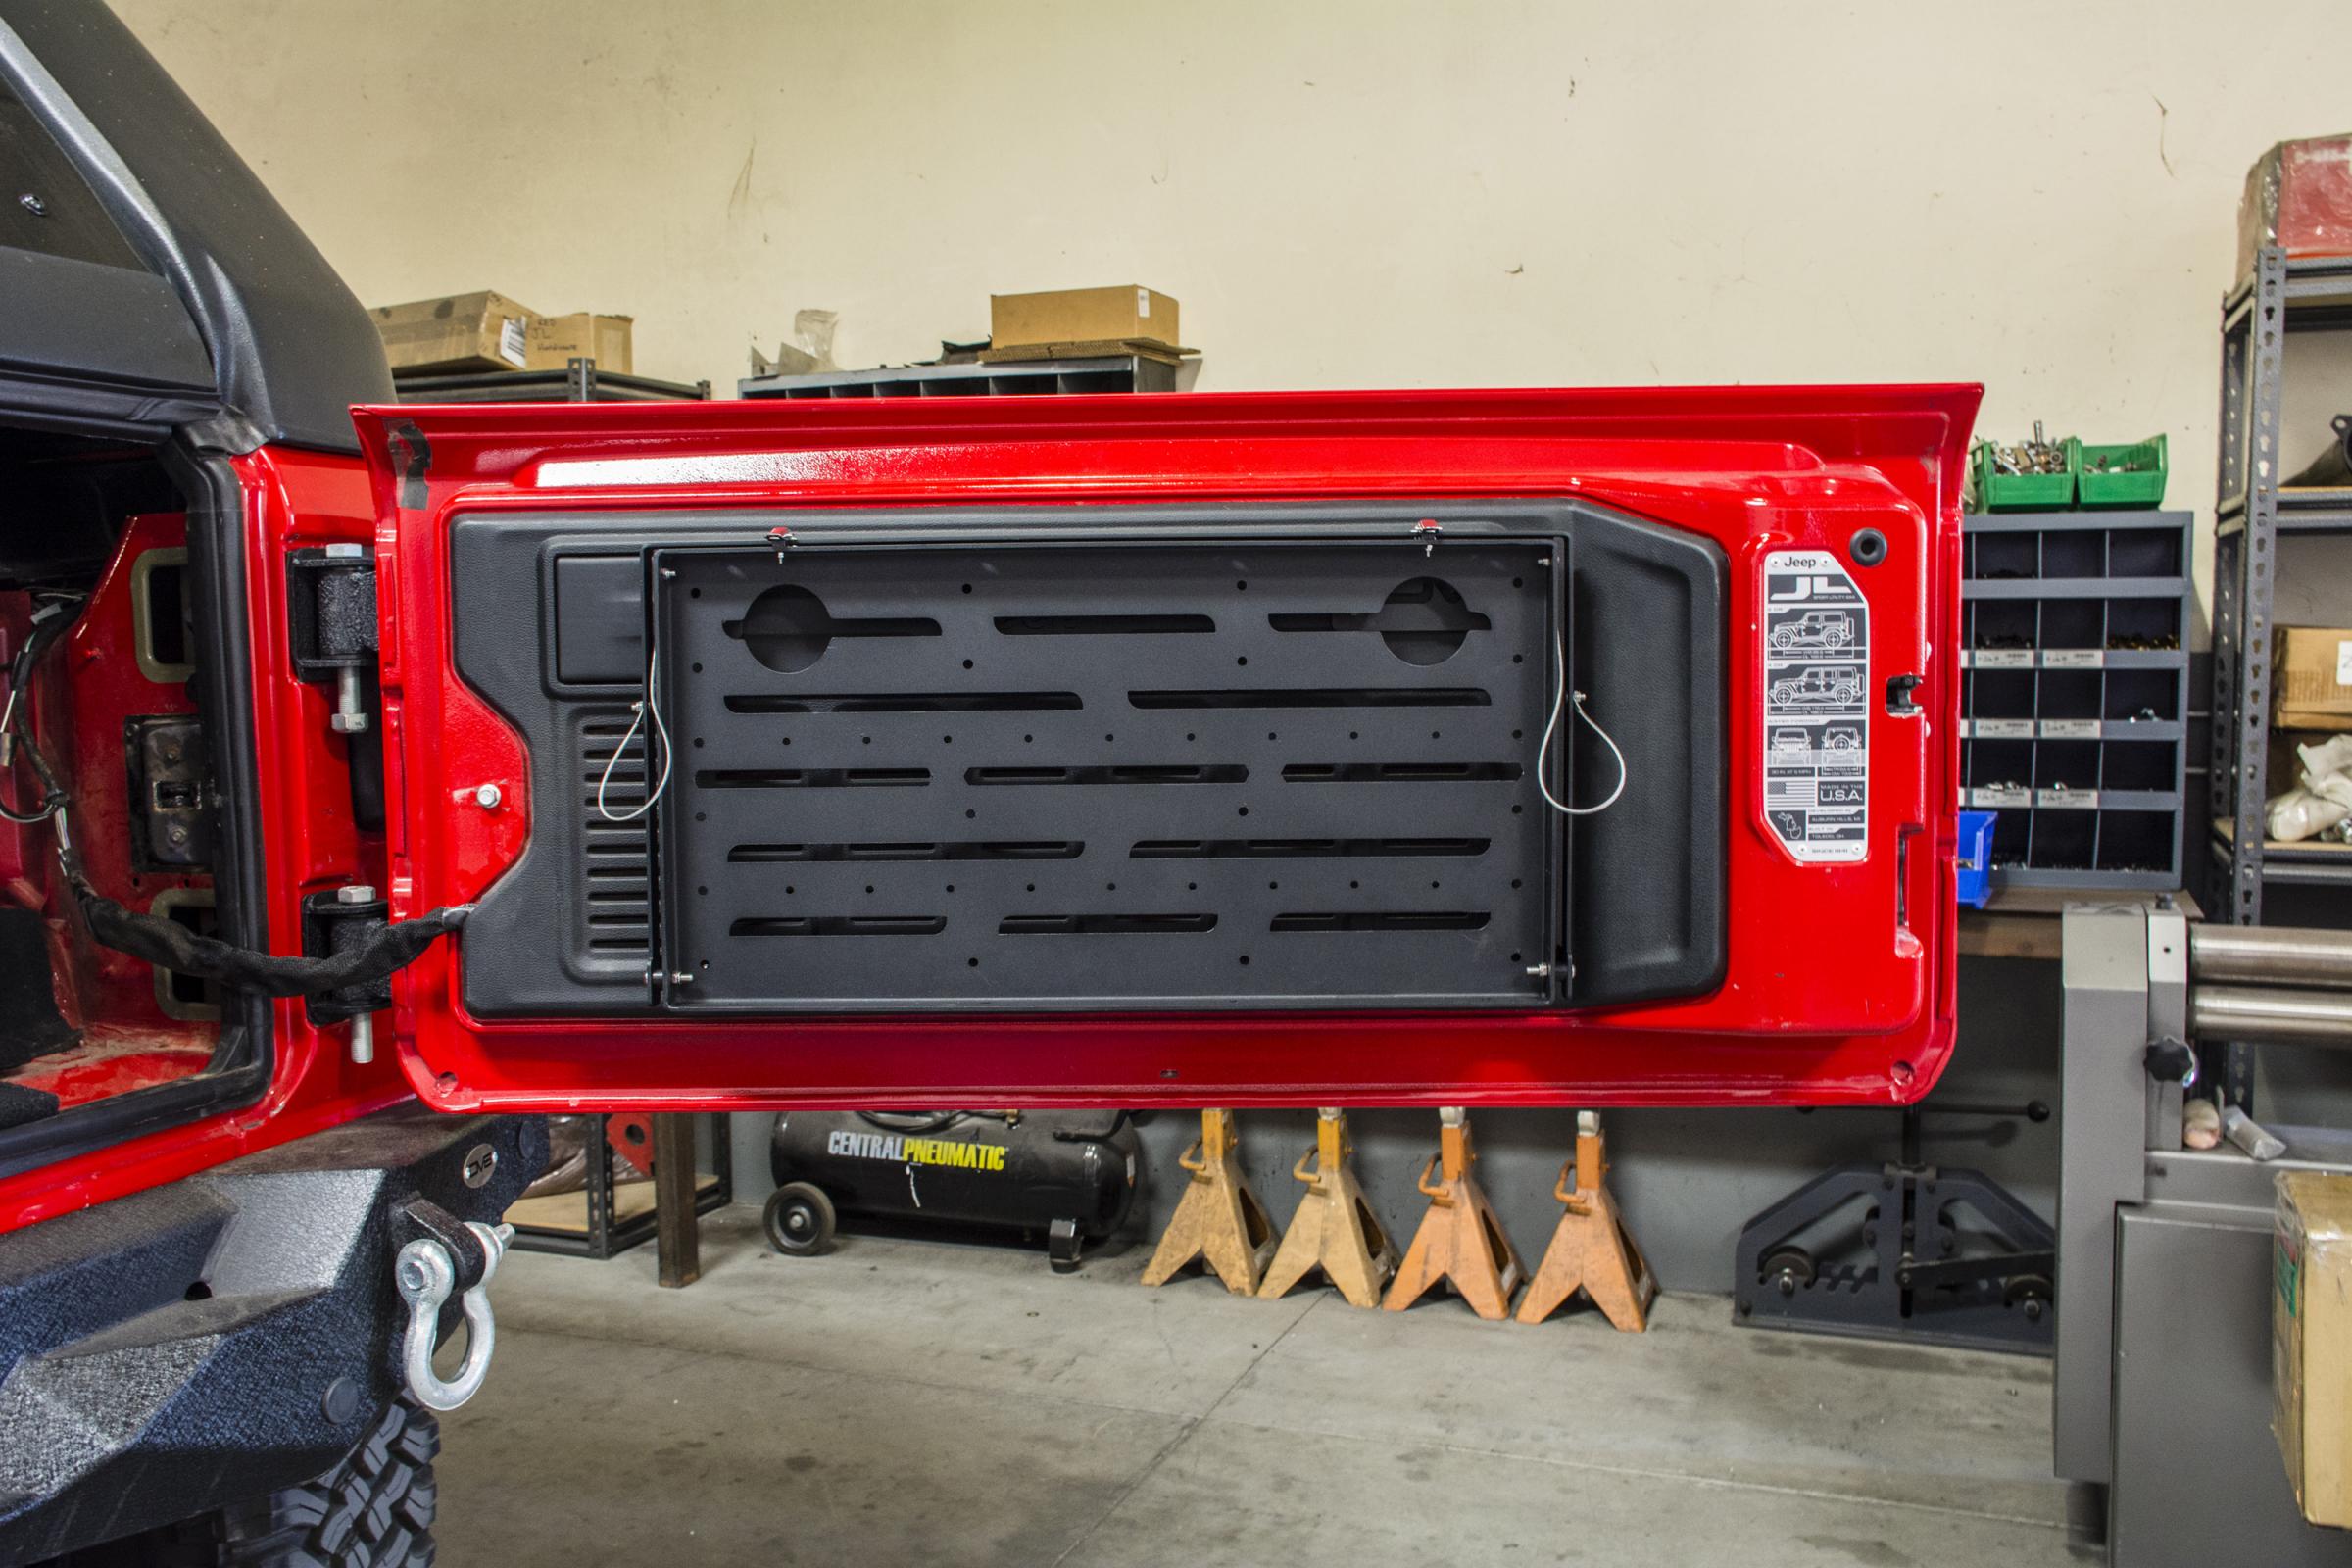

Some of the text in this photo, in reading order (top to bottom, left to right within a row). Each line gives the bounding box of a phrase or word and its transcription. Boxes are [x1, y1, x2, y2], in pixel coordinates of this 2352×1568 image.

[1784, 556, 1817, 568] Jeep
[1770, 576, 1852, 600] JL
[1820, 789, 1863, 802] U.S.A.
[828, 1130, 1005, 1171] CENTRAL PNEUMATIC
